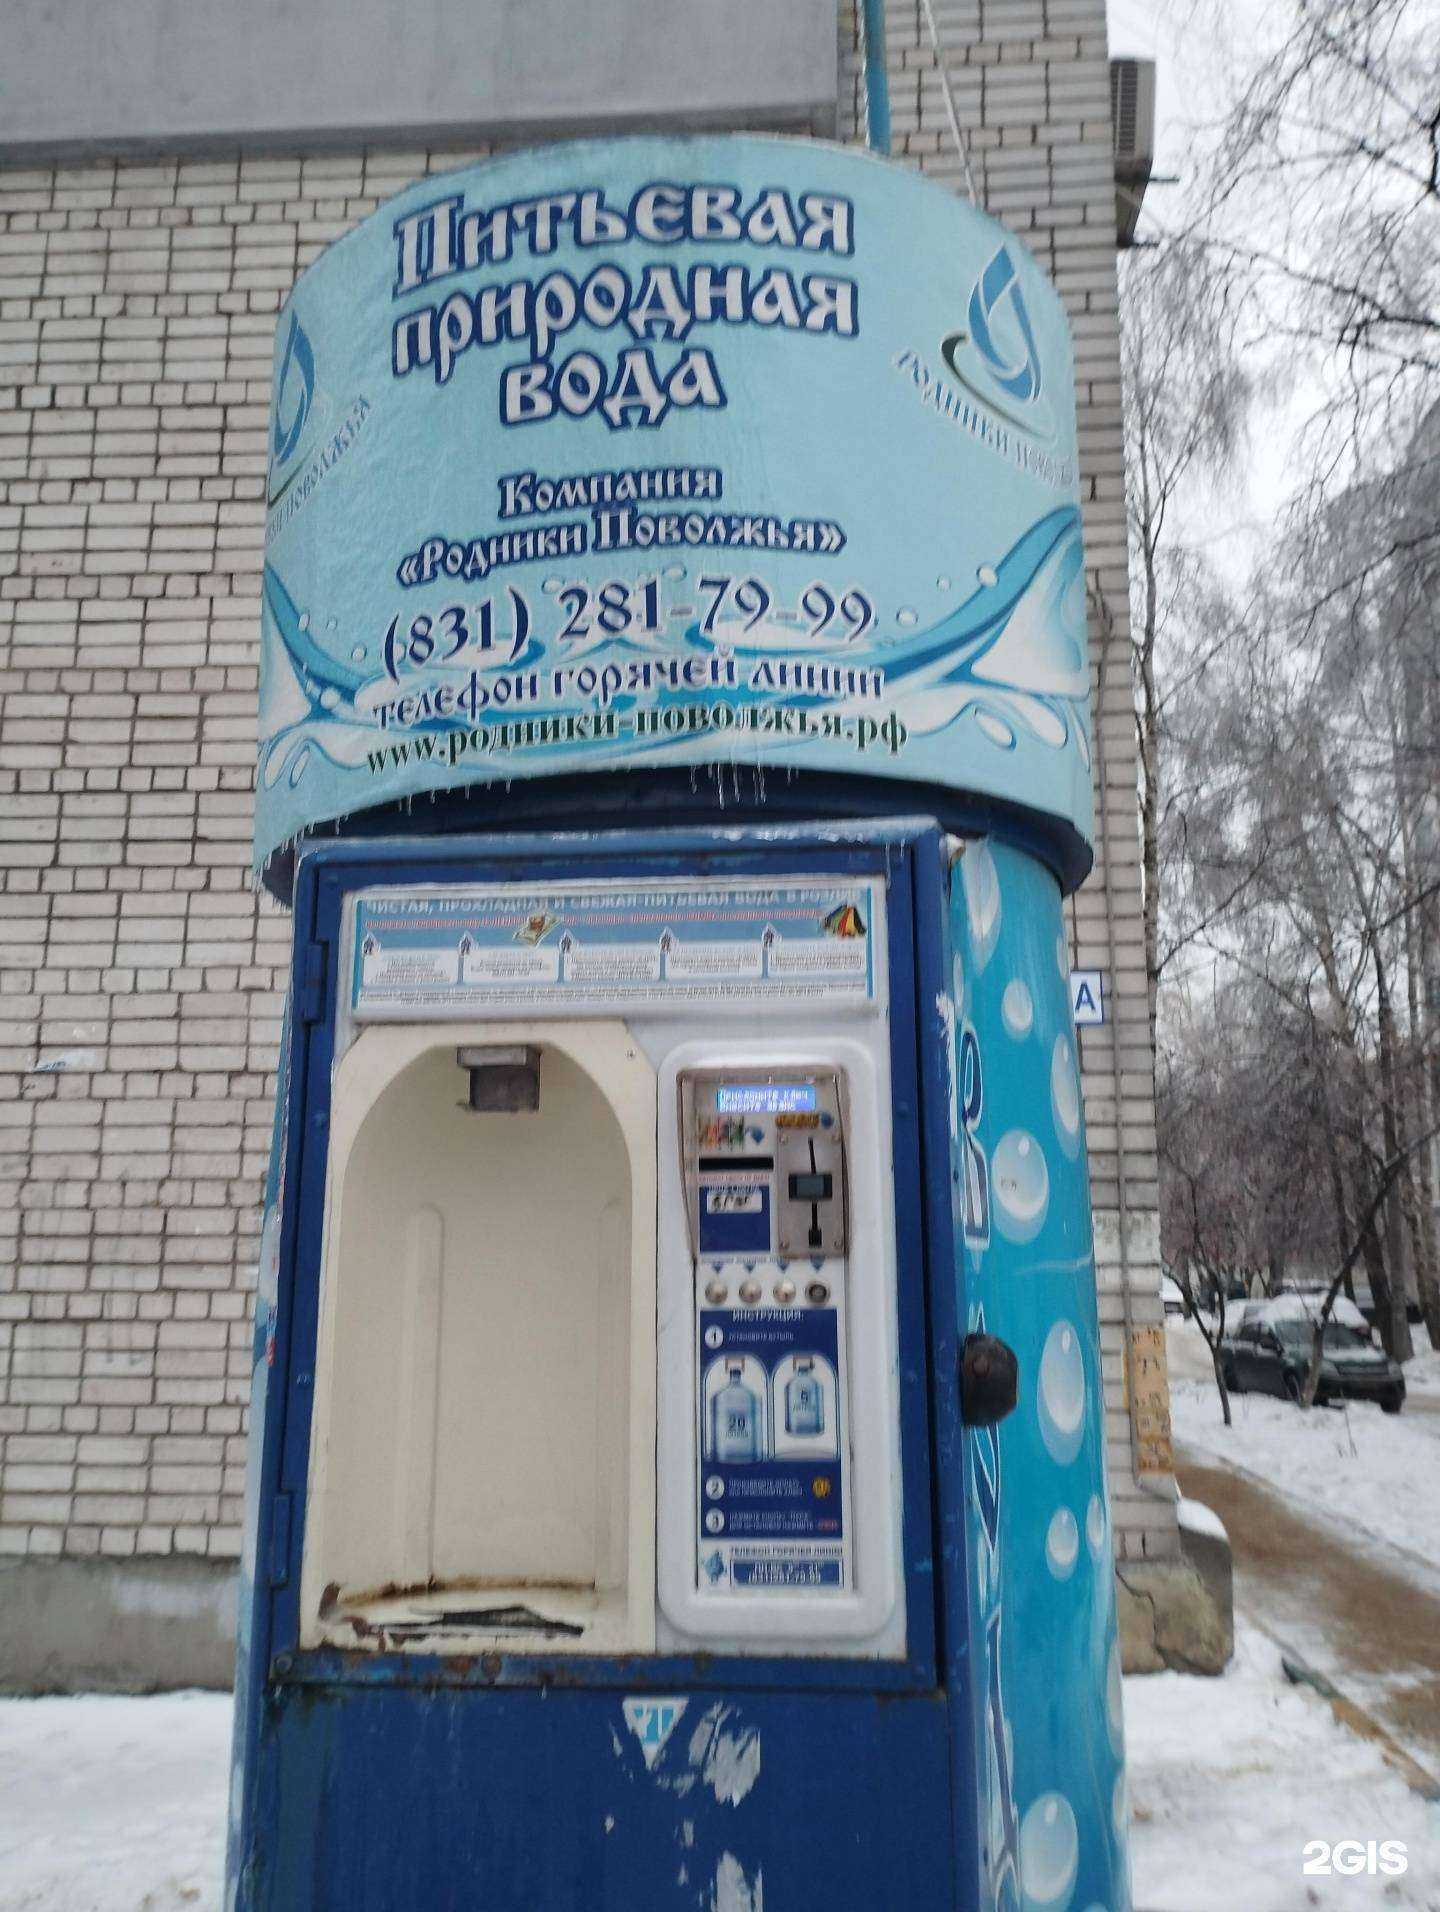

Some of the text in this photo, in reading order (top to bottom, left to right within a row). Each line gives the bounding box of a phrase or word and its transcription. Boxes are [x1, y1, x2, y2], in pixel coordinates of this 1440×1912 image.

[392, 182, 856, 302] Питьевая
[391, 262, 860, 384] природная
[499, 347, 729, 433] вода
[497, 465, 723, 520] Компания
[396, 501, 848, 588] «Родники Поволжья»
[384, 586, 529, 685] (831)
[374, 646, 882, 730] телефон горячей линии
[366, 702, 908, 776] www.родники-поволжья.рф
[1075, 982, 1096, 1011] А
